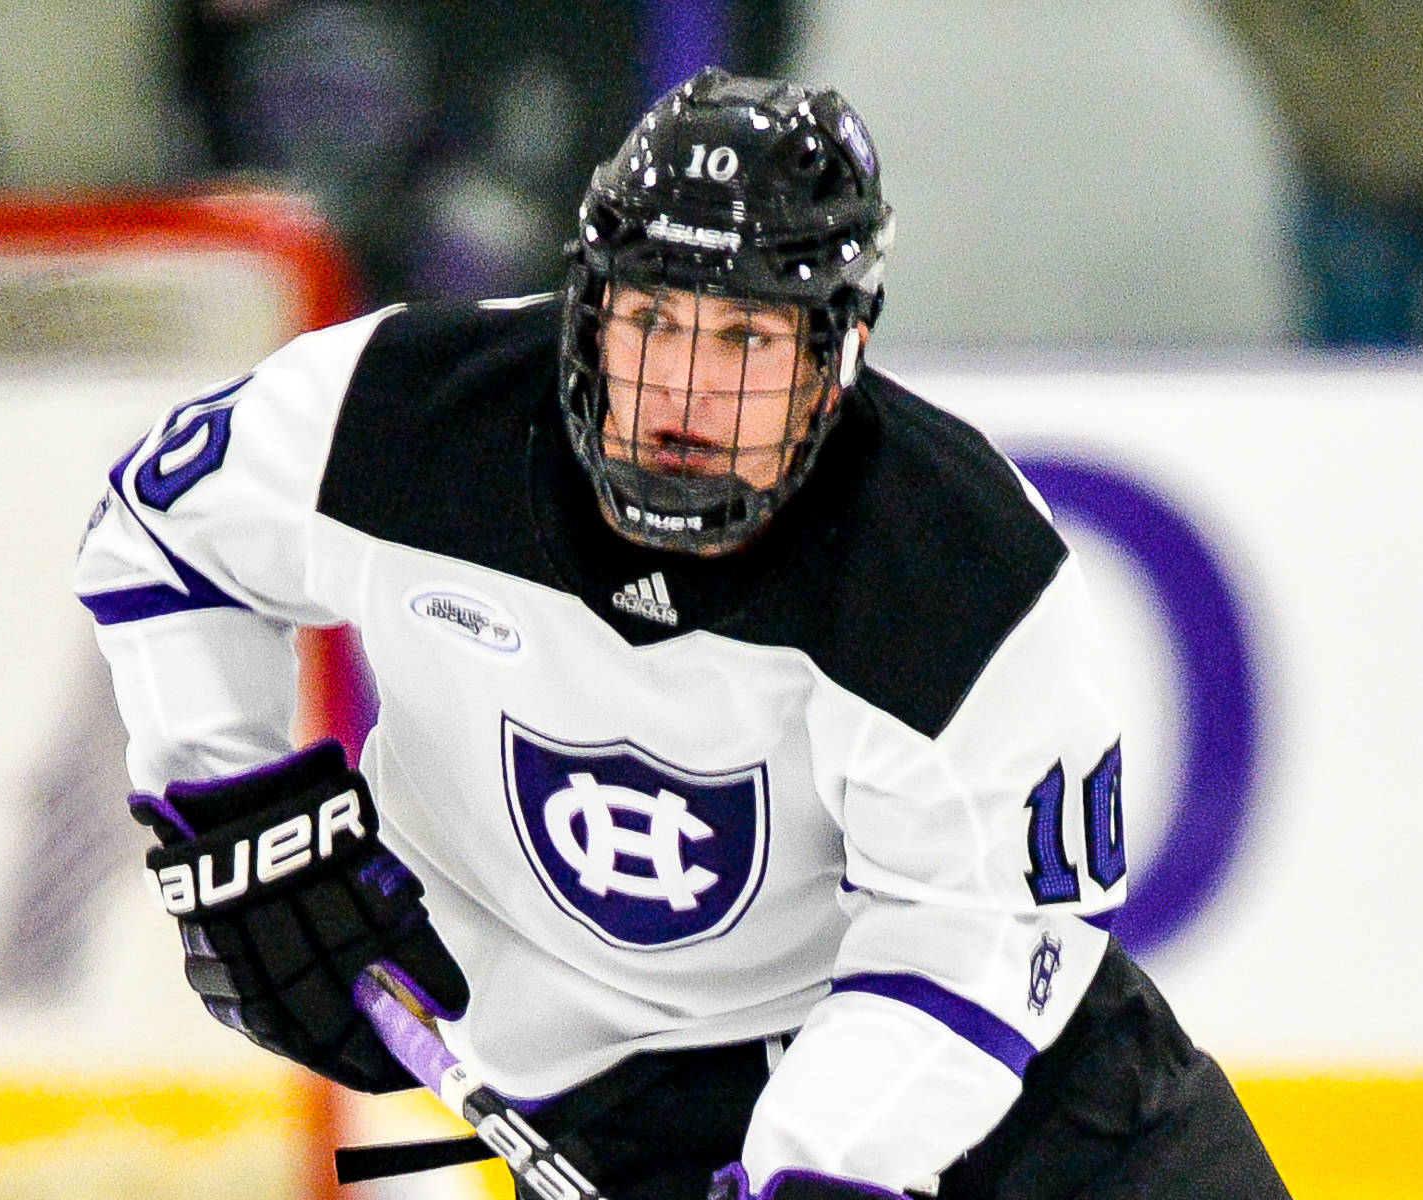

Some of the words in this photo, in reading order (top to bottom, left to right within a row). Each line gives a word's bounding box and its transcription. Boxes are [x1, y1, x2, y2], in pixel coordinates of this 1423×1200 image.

[684, 143, 739, 182] 10
[612, 592, 678, 627] adidas
[1023, 732, 1127, 907] 10
